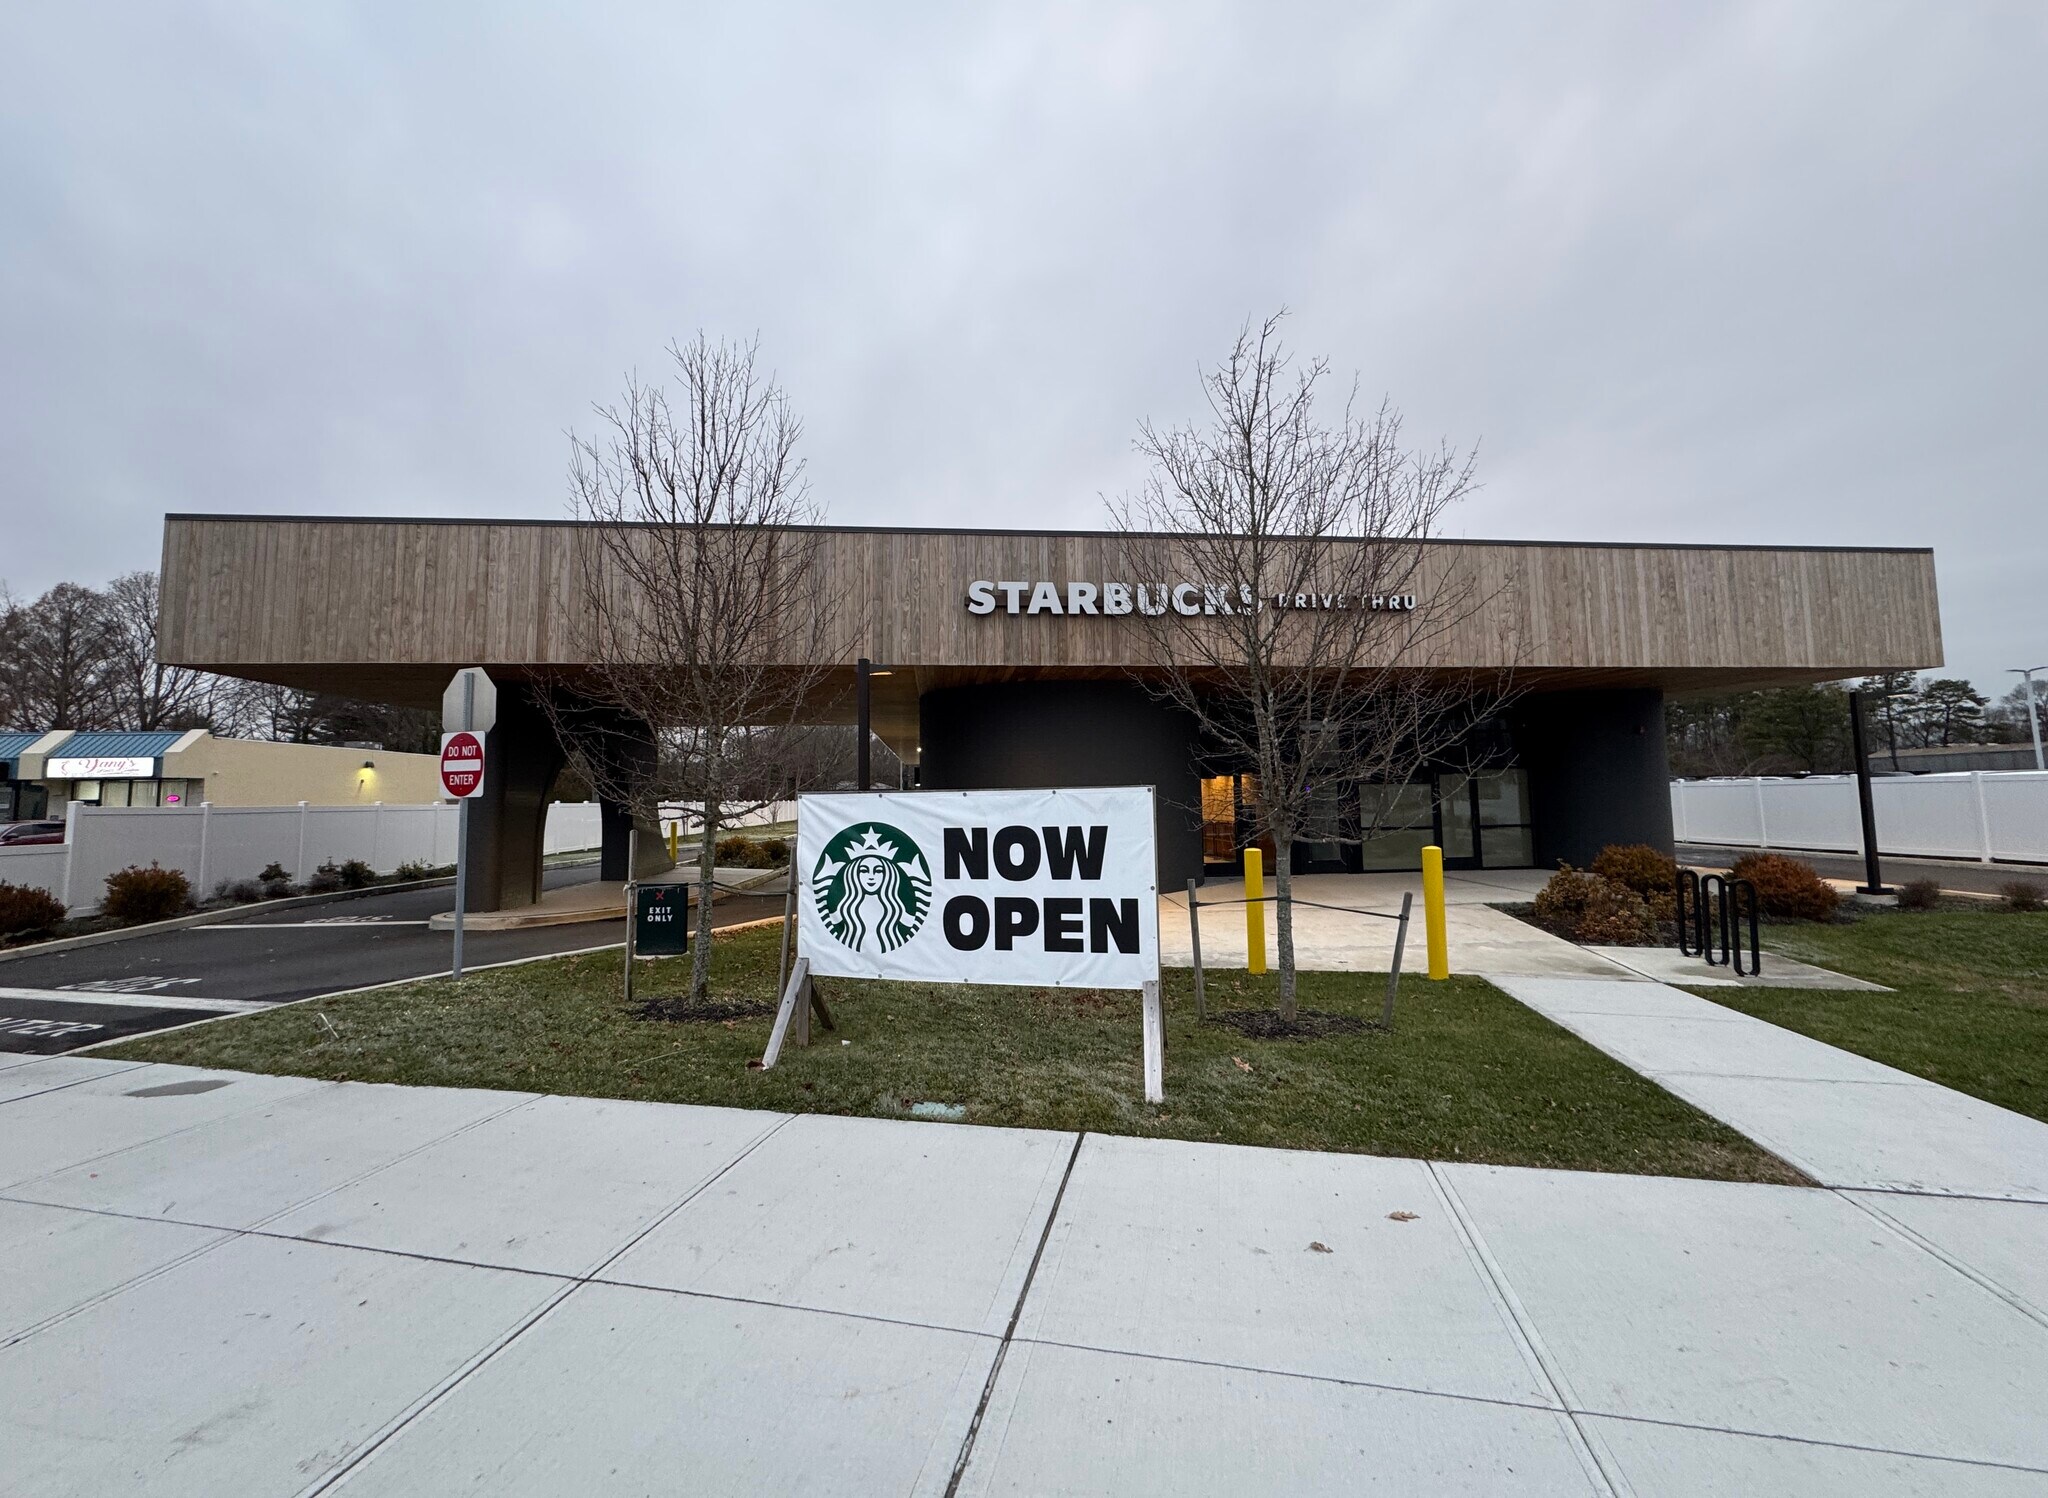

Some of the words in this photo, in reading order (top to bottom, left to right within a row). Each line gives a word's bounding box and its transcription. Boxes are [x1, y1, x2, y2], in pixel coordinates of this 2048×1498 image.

[967, 580, 1263, 616] STARBUCKS
[448, 746, 459, 757] DO
[462, 745, 477, 756] NOT
[449, 774, 474, 785] ENTER
[943, 825, 1109, 882] NOW
[649, 906, 672, 914] EXIT
[647, 914, 673, 922] ONLY
[942, 894, 1141, 954] OPEN
